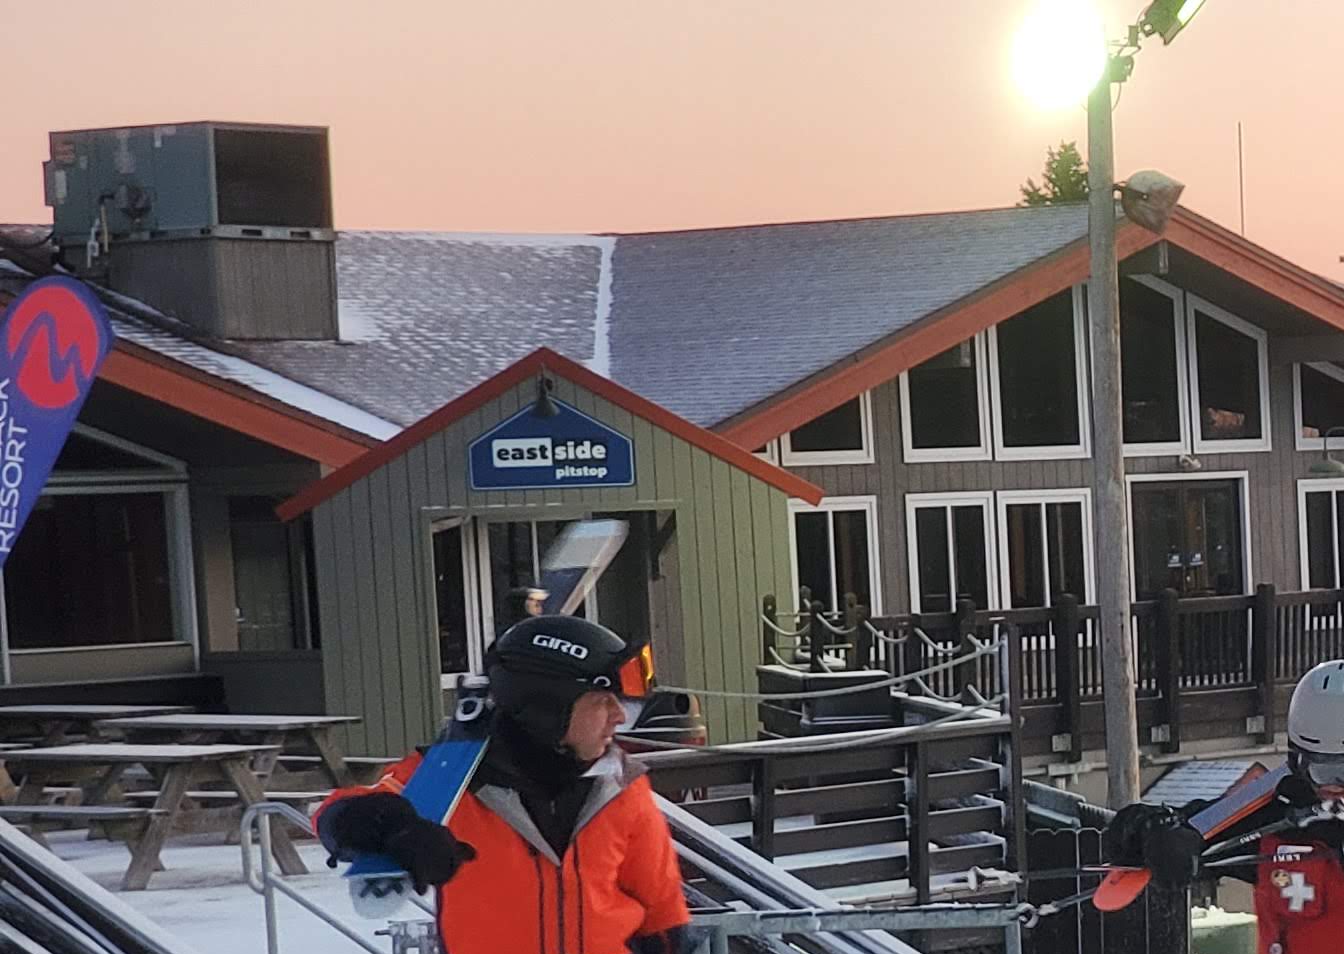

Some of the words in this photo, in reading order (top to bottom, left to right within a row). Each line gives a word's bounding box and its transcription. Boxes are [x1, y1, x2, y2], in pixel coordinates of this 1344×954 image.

[496, 444, 549, 461] east
[554, 441, 607, 460] side
[555, 465, 608, 480] pitstop
[0, 417, 28, 553] RESORT
[532, 634, 589, 660] GIRO
